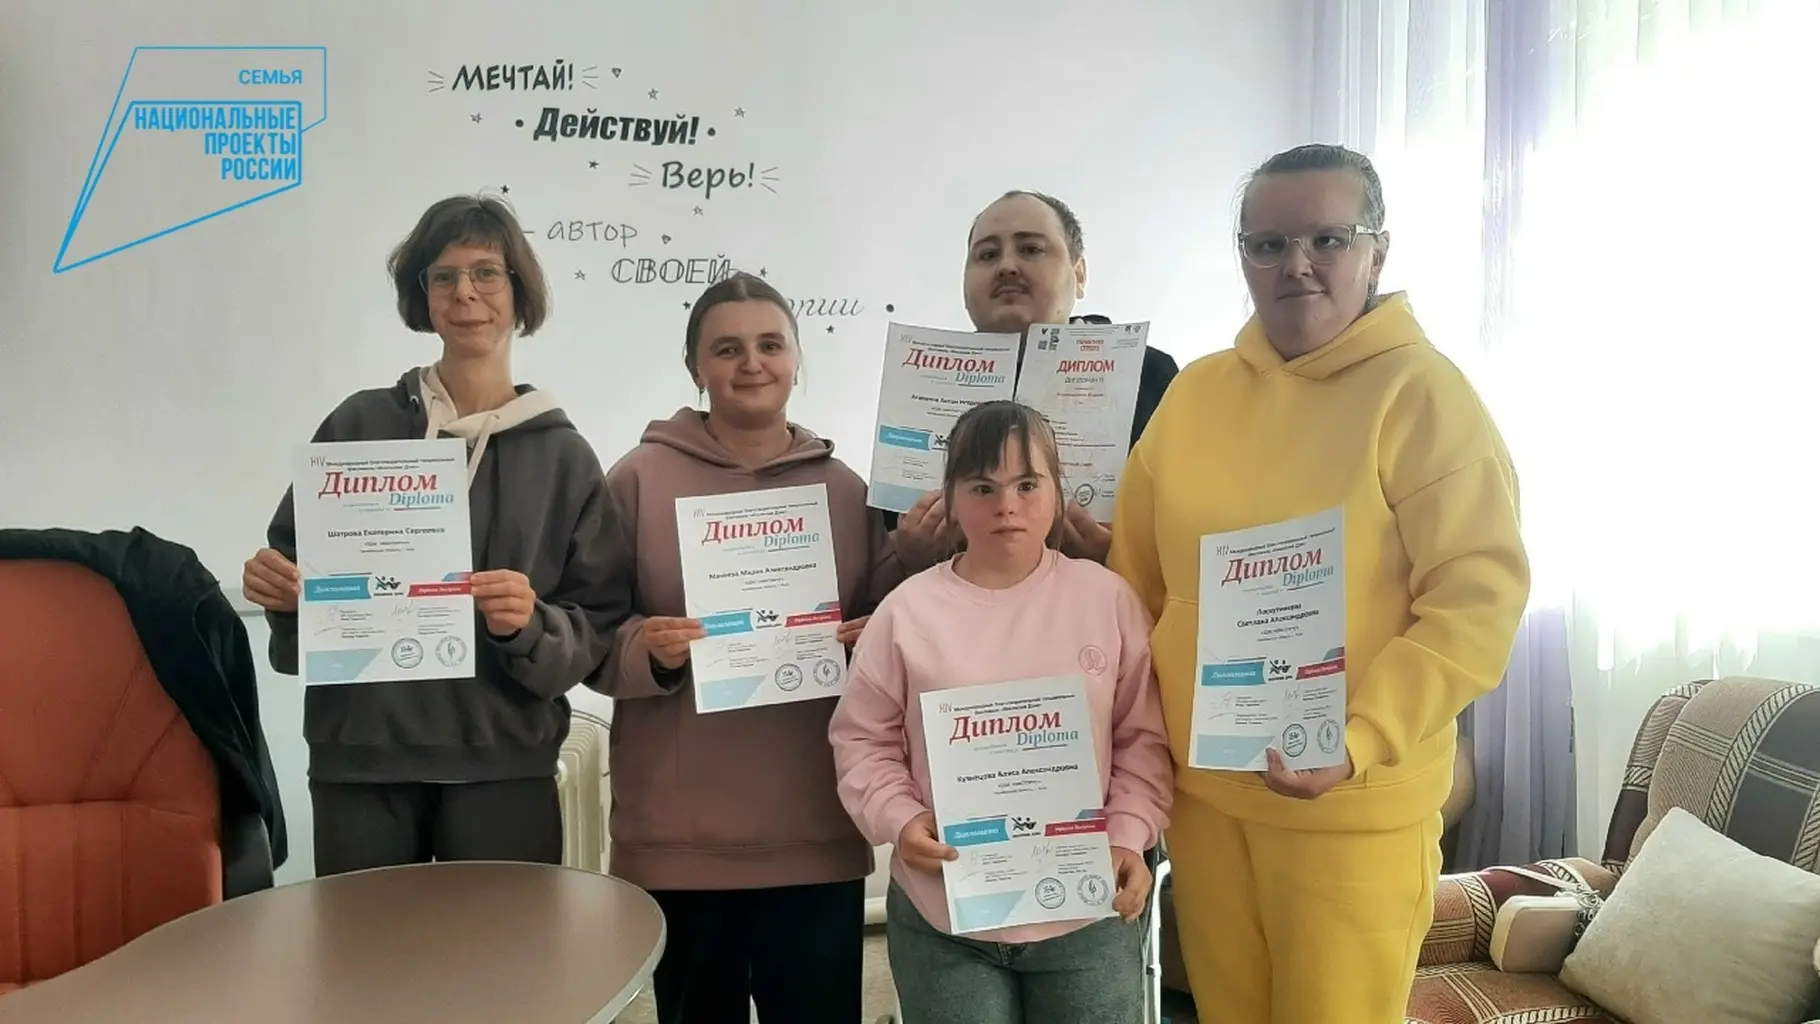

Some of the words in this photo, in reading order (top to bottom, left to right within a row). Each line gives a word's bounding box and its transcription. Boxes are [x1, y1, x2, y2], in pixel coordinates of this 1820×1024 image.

[451, 59, 574, 91] МЕЧТАЙ!
[532, 107, 699, 146] Действуй!
[661, 161, 754, 199] Верь!
[610, 254, 731, 284] СВОЕЙ
[901, 347, 996, 374] Диплом
[1056, 359, 1115, 374] ДИПЛОМ
[955, 371, 1006, 385] Diploma
[318, 471, 438, 499] Диплом
[389, 491, 454, 508] Diploma
[701, 516, 804, 546] Диплом
[764, 532, 820, 549] Diploma
[1221, 547, 1323, 587] Диплом
[1282, 565, 1335, 586] Diploma
[949, 711, 1062, 745] Диплом
[1016, 729, 1079, 748] Diploma
